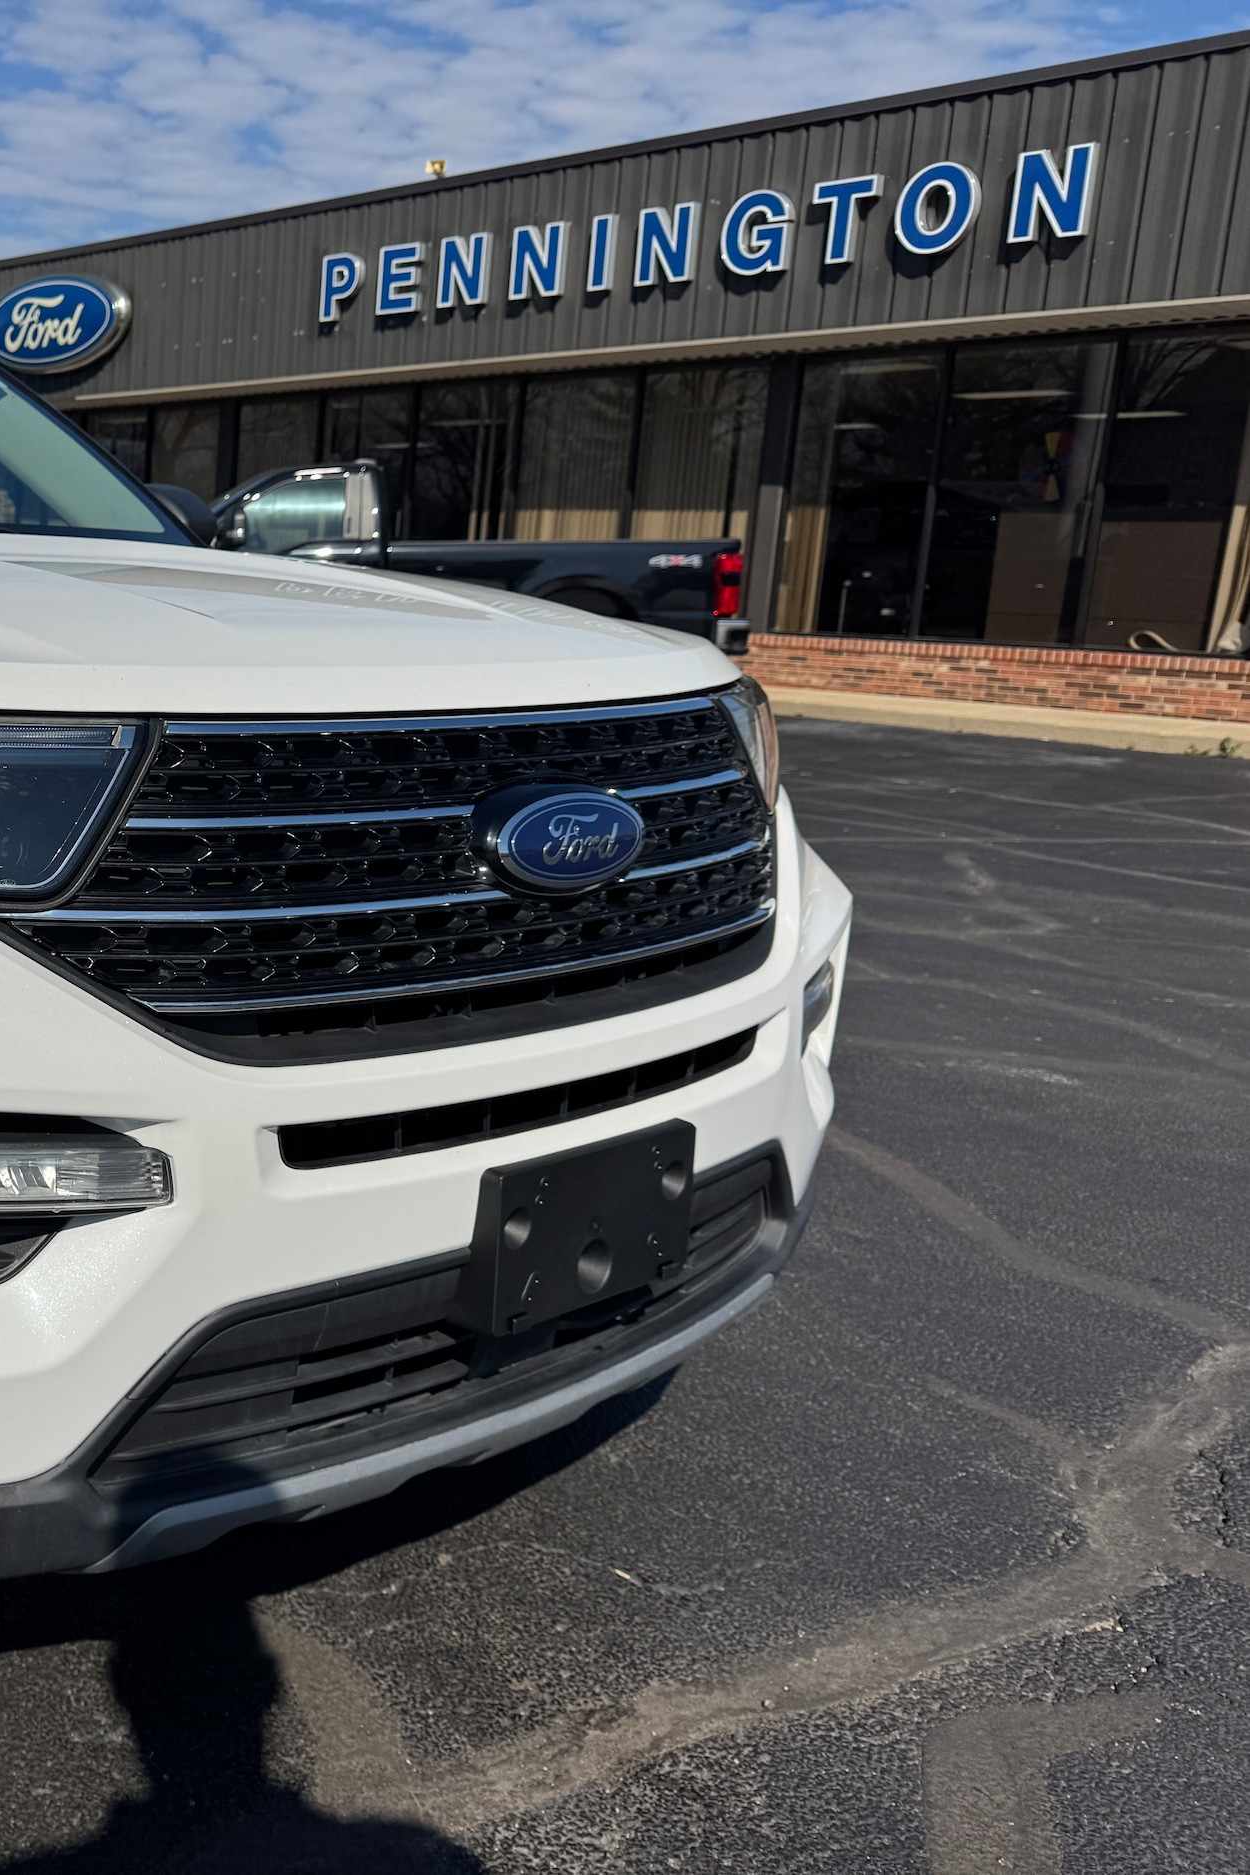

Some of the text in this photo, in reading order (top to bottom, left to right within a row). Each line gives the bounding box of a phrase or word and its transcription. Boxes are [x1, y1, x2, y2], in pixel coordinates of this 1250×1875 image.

[319, 141, 1100, 324] PENNINGTON
[4, 293, 85, 353] Ford
[543, 813, 618, 865] Ford
